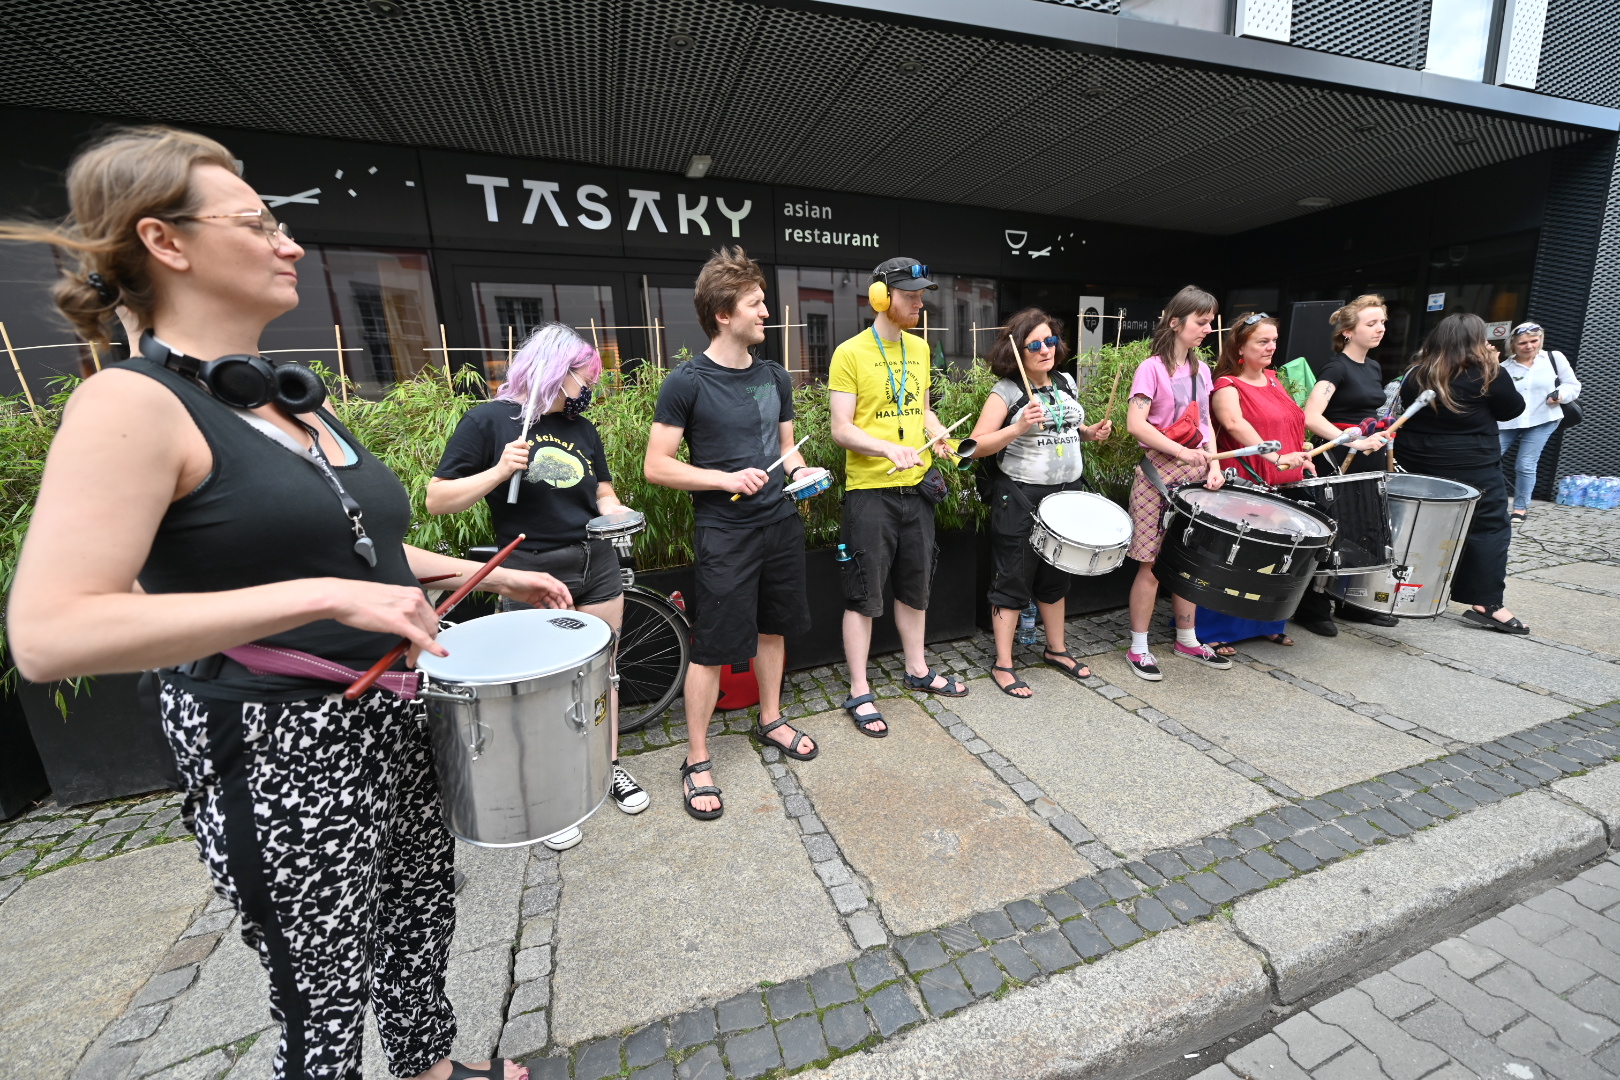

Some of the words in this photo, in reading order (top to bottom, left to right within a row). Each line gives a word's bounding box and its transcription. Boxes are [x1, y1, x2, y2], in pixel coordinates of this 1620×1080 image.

[465, 174, 752, 238] TASAKY
[783, 200, 832, 220] asian
[784, 228, 880, 248] restaurant
